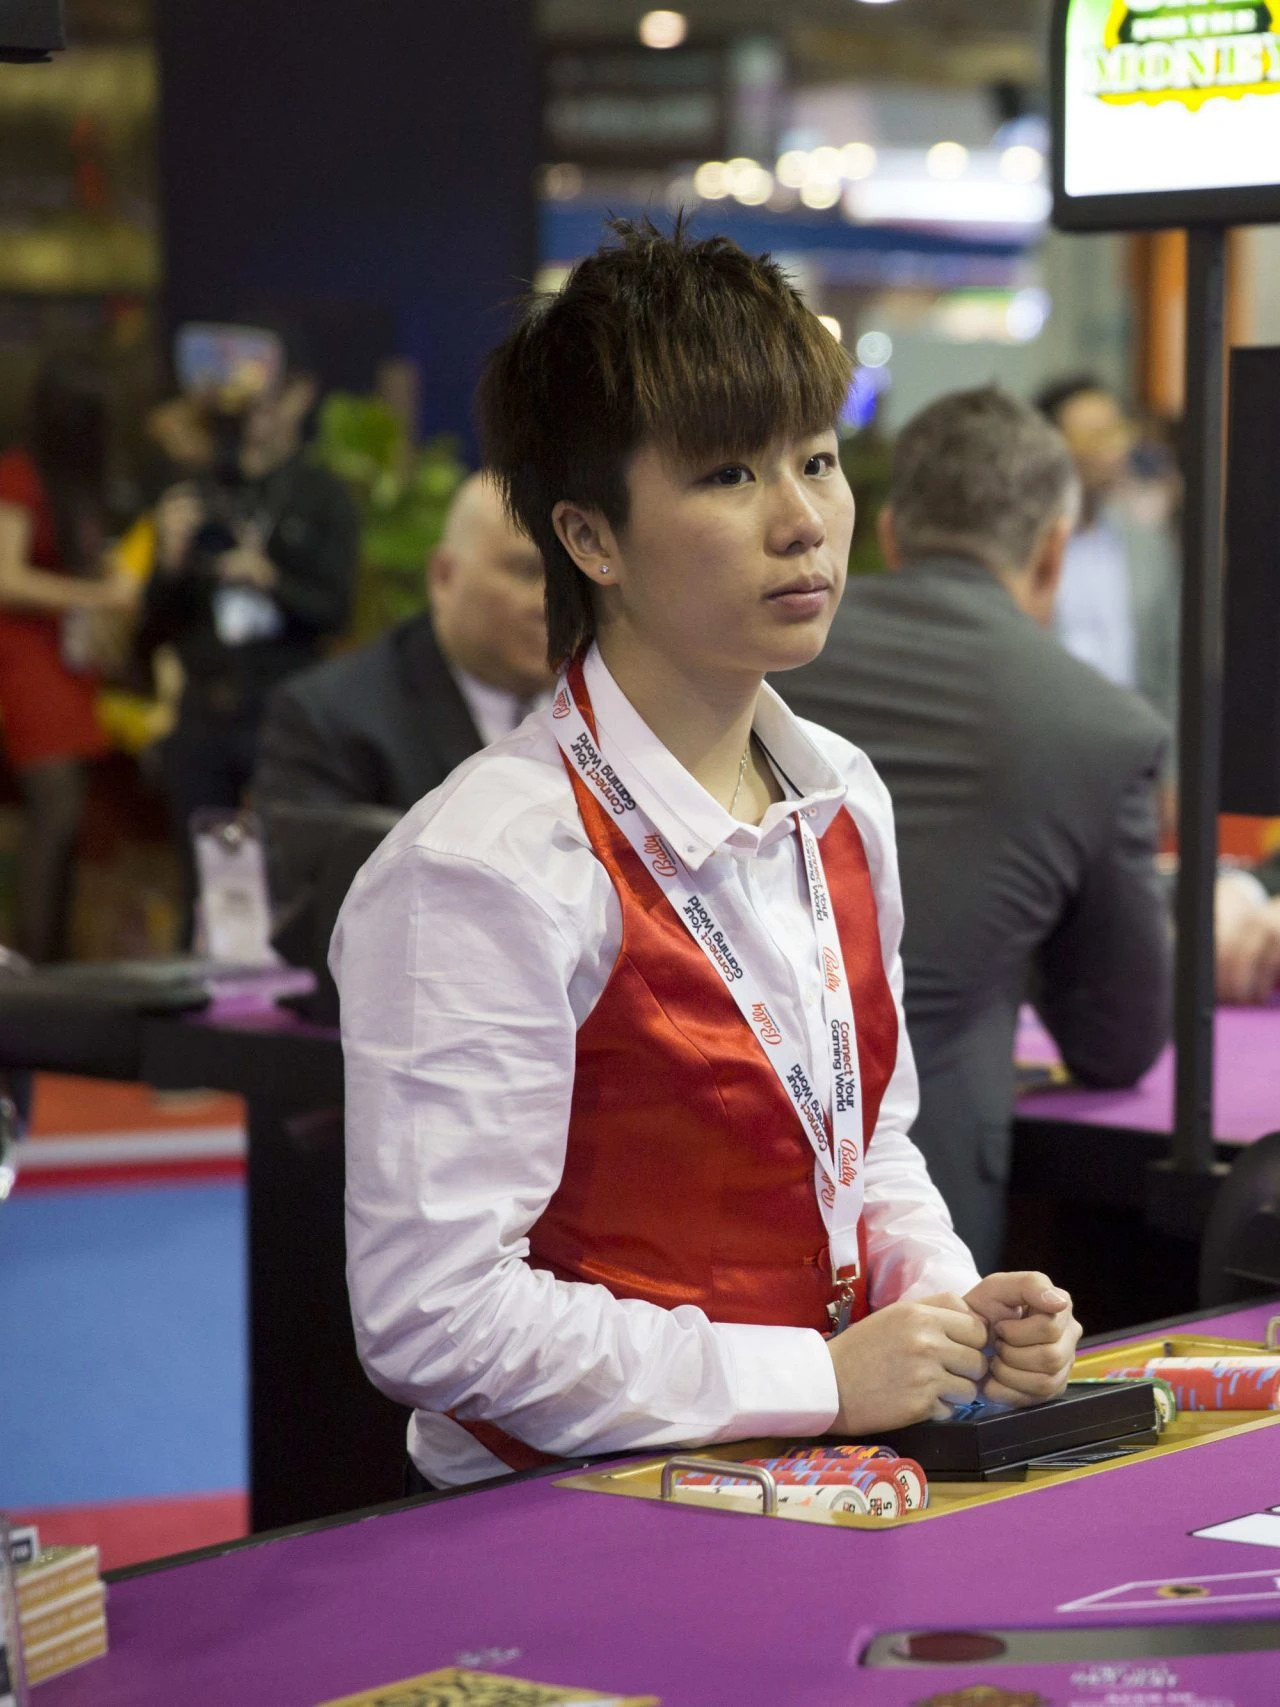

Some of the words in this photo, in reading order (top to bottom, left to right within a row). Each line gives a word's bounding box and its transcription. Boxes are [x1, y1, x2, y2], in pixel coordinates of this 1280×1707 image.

[570, 743, 592, 770] Your
[577, 732, 602, 769] World
[586, 767, 625, 815] Connect
[600, 764, 637, 811] Gaming
[644, 832, 678, 877] Bally
[809, 837, 824, 889] Connect
[820, 891, 829, 919] Your
[683, 906, 703, 934] Your
[688, 895, 715, 934] World
[812, 884, 825, 922] World
[700, 931, 735, 983] Connect
[712, 931, 744, 979] Gaming
[823, 945, 842, 993] Bally
[751, 1001, 783, 1045] Bally
[831, 1019, 842, 1071] Gaming
[839, 1021, 855, 1077] Connect
[786, 1074, 803, 1103] Your
[790, 1063, 814, 1100] World
[834, 1072, 847, 1113] World
[845, 1078, 855, 1109] Your
[800, 1100, 828, 1152] Connect
[838, 1138, 858, 1187] Bally
[883, 1501, 893, 1510] 5
